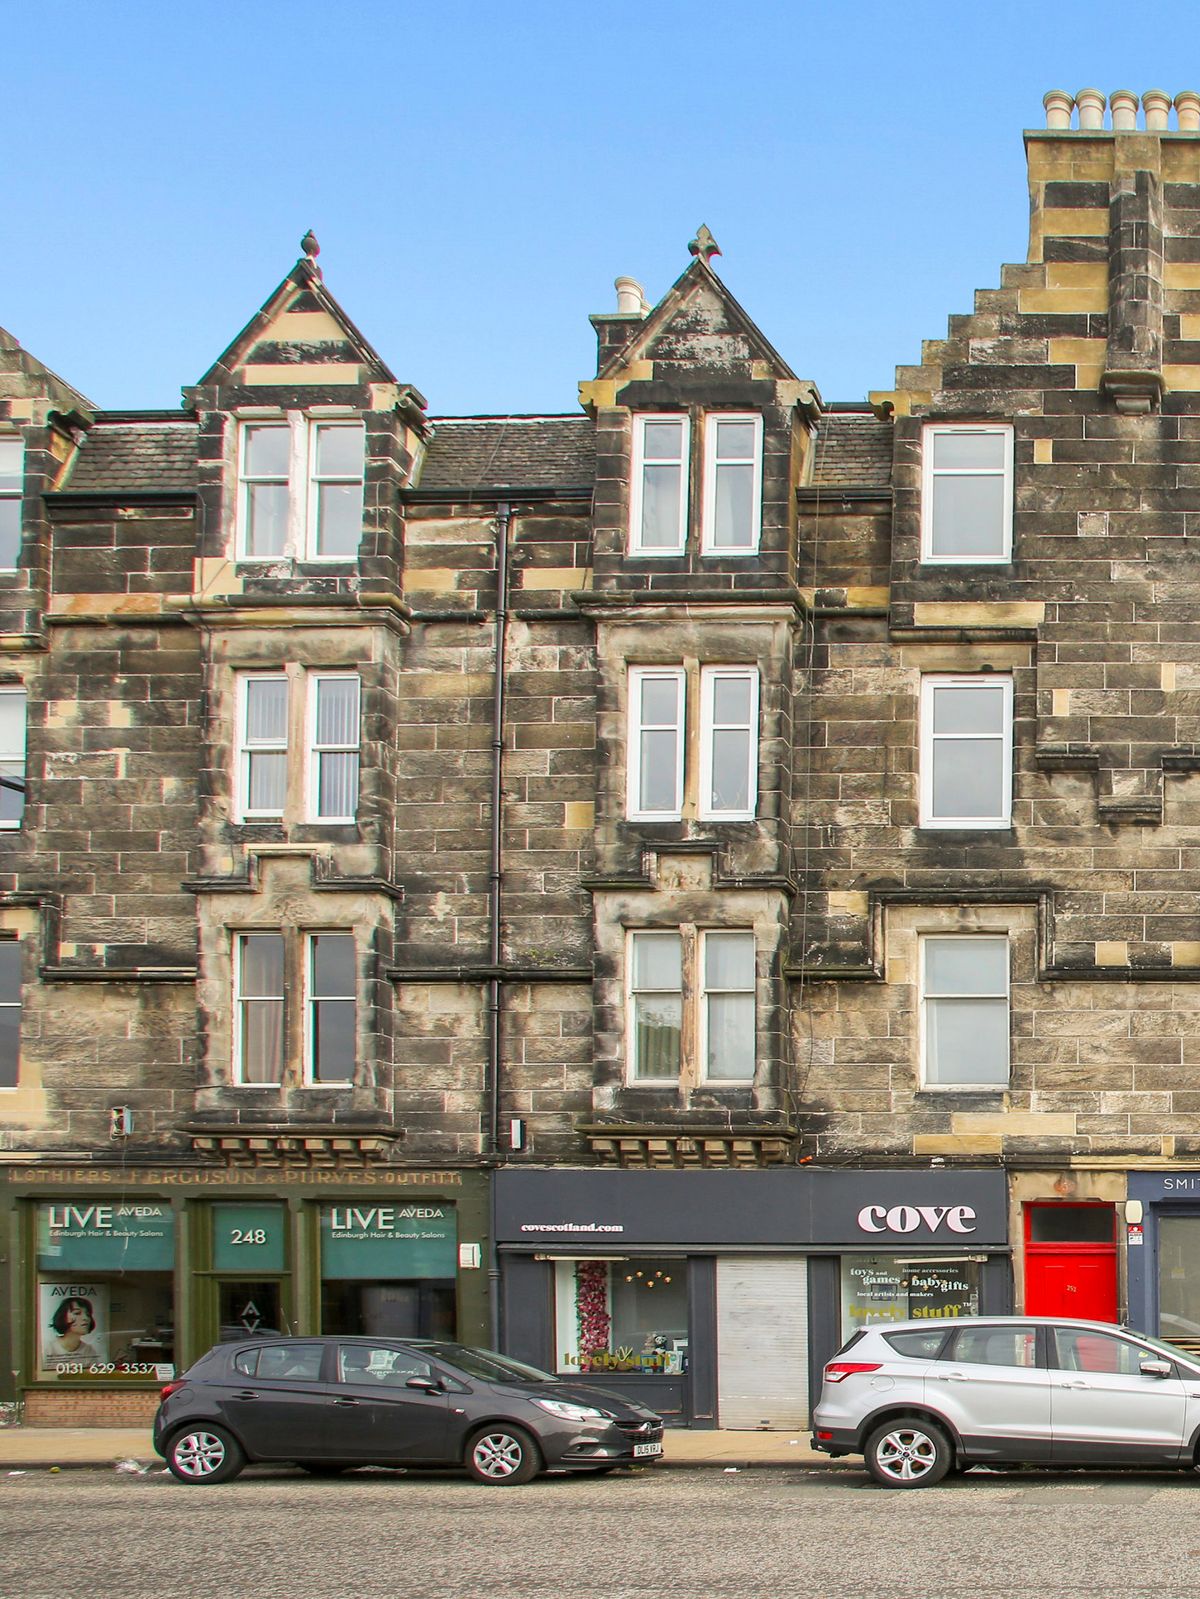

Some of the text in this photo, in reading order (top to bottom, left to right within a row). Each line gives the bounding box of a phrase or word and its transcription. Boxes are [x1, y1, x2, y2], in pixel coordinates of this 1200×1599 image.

[49, 1206, 162, 1228] LIVE AVEDA
[331, 1208, 444, 1230] LIVE AVEDA
[858, 1205, 977, 1233] cove
[521, 1222, 624, 1232] covescotland.com
[49, 1230, 86, 1238] Edinburgh
[113, 1230, 138, 1238] Beauty
[231, 1229, 266, 1245] 248
[332, 1231, 368, 1239] Edinburgh
[395, 1231, 419, 1239] Beauty
[850, 1268, 874, 1277] toys
[862, 1275, 901, 1286] games
[911, 1277, 942, 1288] baby
[940, 1280, 969, 1292] gifts
[52, 1286, 97, 1297] AVEDA
[912, 1303, 962, 1318] stuff
[56, 1363, 83, 1374] 0131
[89, 1363, 116, 1374] 629
[121, 1363, 156, 1374] 3537
